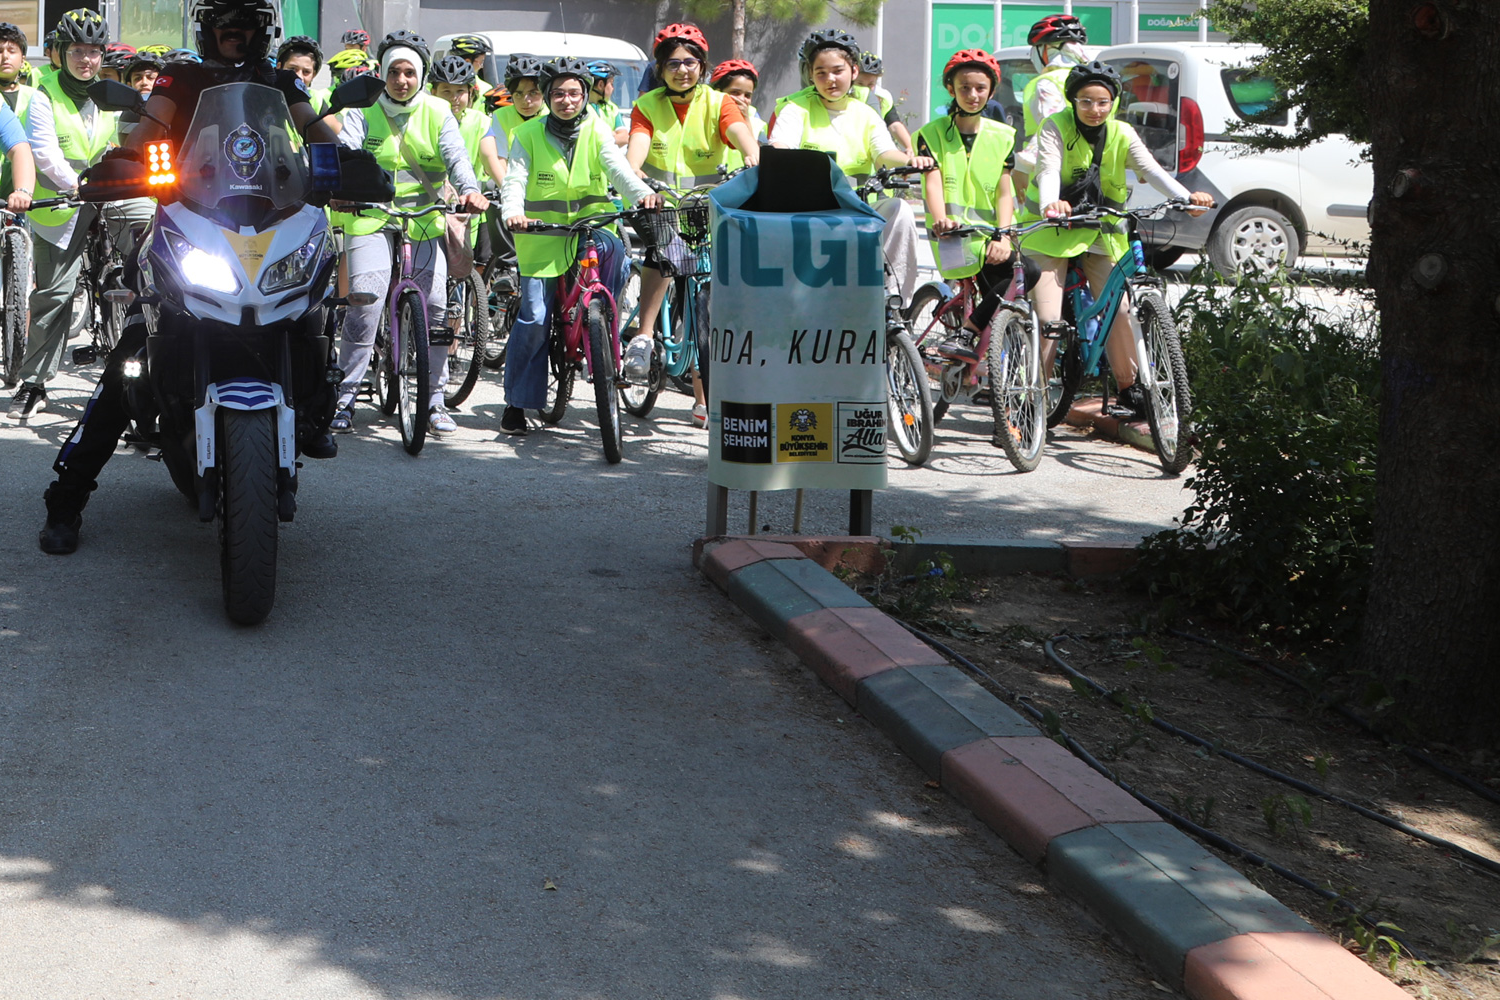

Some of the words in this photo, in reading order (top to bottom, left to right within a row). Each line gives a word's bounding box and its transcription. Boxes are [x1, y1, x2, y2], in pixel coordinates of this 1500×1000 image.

[229, 183, 263, 191] Kawasaki
[854, 408, 883, 419] UĞUR
[842, 428, 888, 448] Alta
